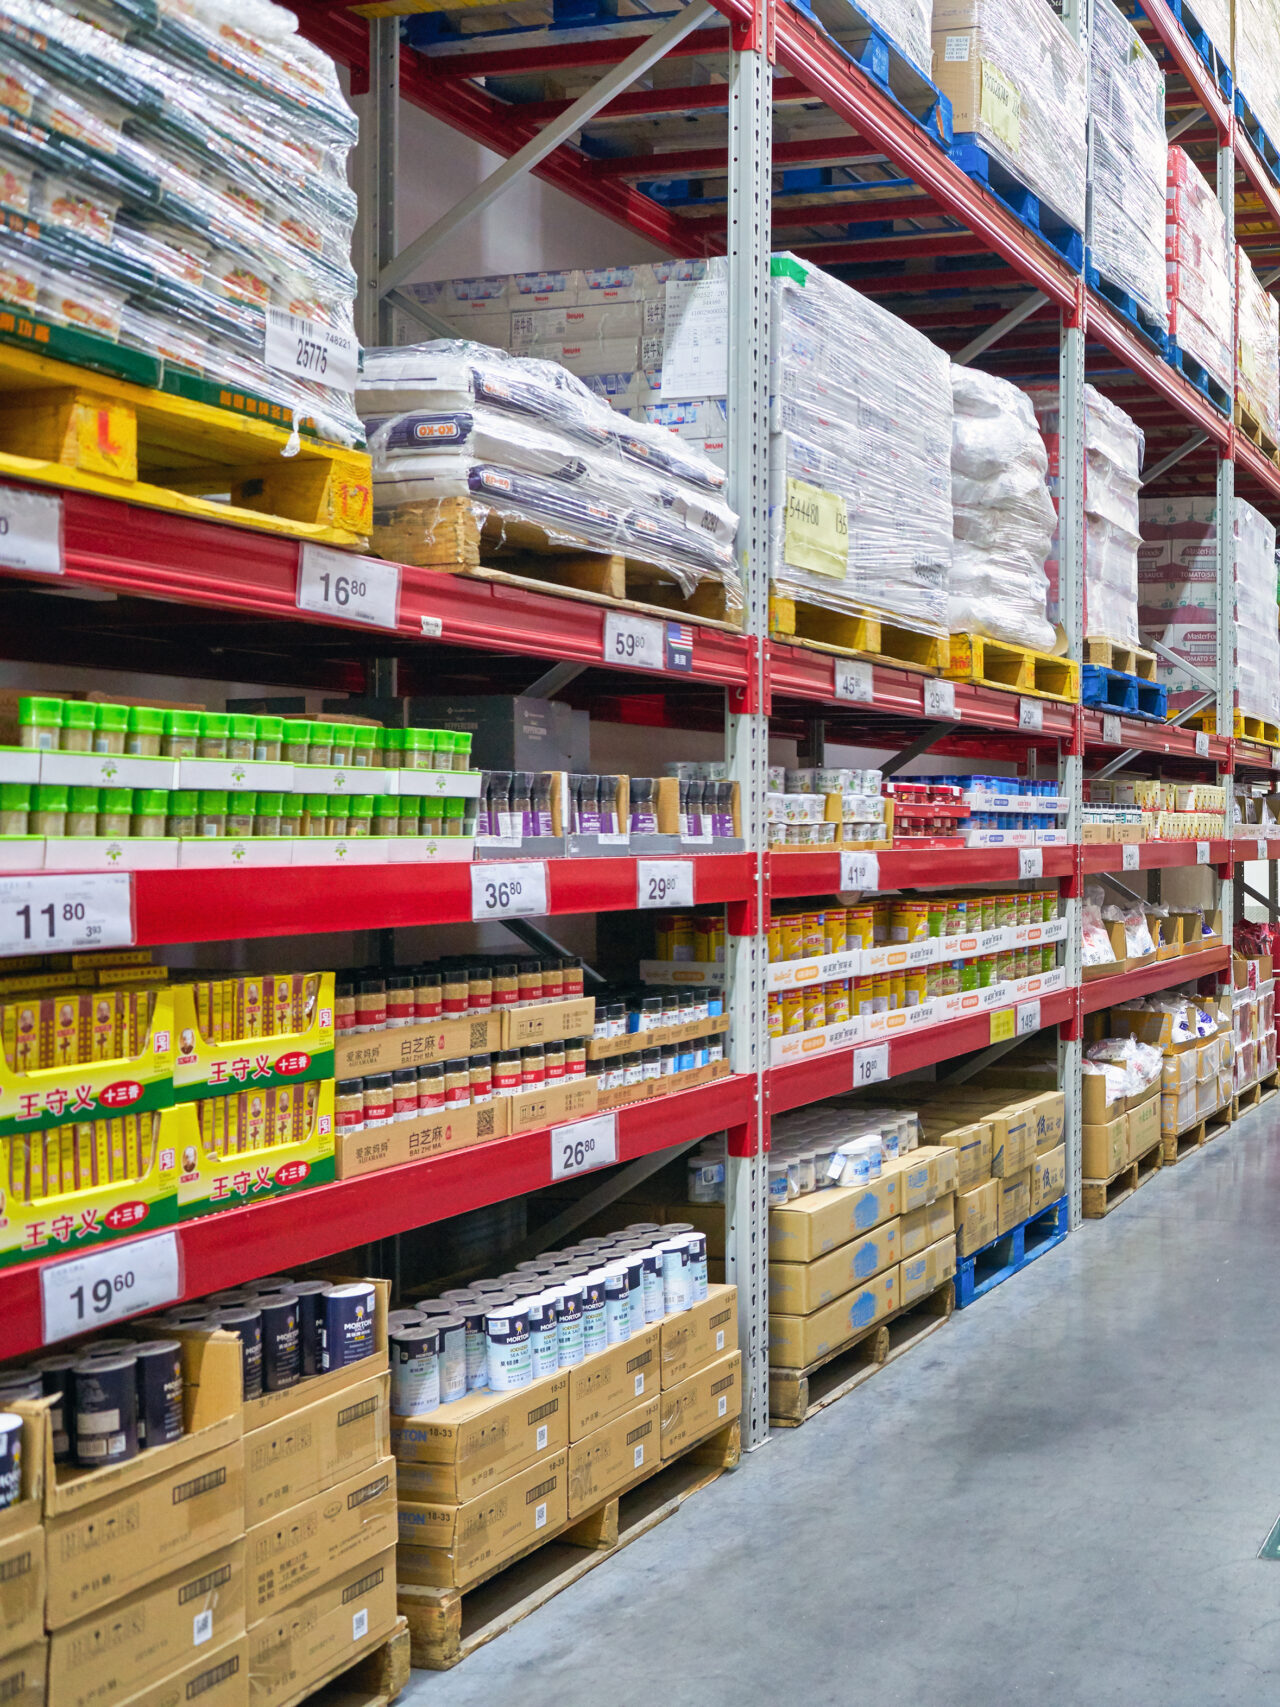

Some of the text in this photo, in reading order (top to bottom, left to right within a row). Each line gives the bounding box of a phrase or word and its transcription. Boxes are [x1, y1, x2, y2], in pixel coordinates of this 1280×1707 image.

[295, 337, 328, 375] 25775
[418, 424, 455, 437] KO-KO
[400, 1035, 436, 1056] 白芝麻
[346, 1048, 380, 1063] 爱家妈妈
[401, 1050, 434, 1065] BAI ZHI MA
[208, 1054, 308, 1085] 王守义 十三香
[16, 1084, 140, 1119] 王守义 十三香
[408, 1126, 443, 1148] 白芝麻
[355, 1141, 389, 1159] 爱家妈妈
[409, 1141, 442, 1157] BAI ZHI MA
[209, 1164, 308, 1202] 王守义 十三香
[22, 1203, 146, 1251] 王守义 十三香
[582, 1300, 605, 1312] MORTON
[343, 1317, 373, 1331] MORTON
[558, 1310, 582, 1323] MORTON
[540, 1321, 557, 1332] MORTO
[276, 1328, 299, 1342] MORTO
[506, 1330, 530, 1344] MORTON
[429, 1427, 453, 1438] 18-33
[427, 1511, 451, 1523] 18-33
